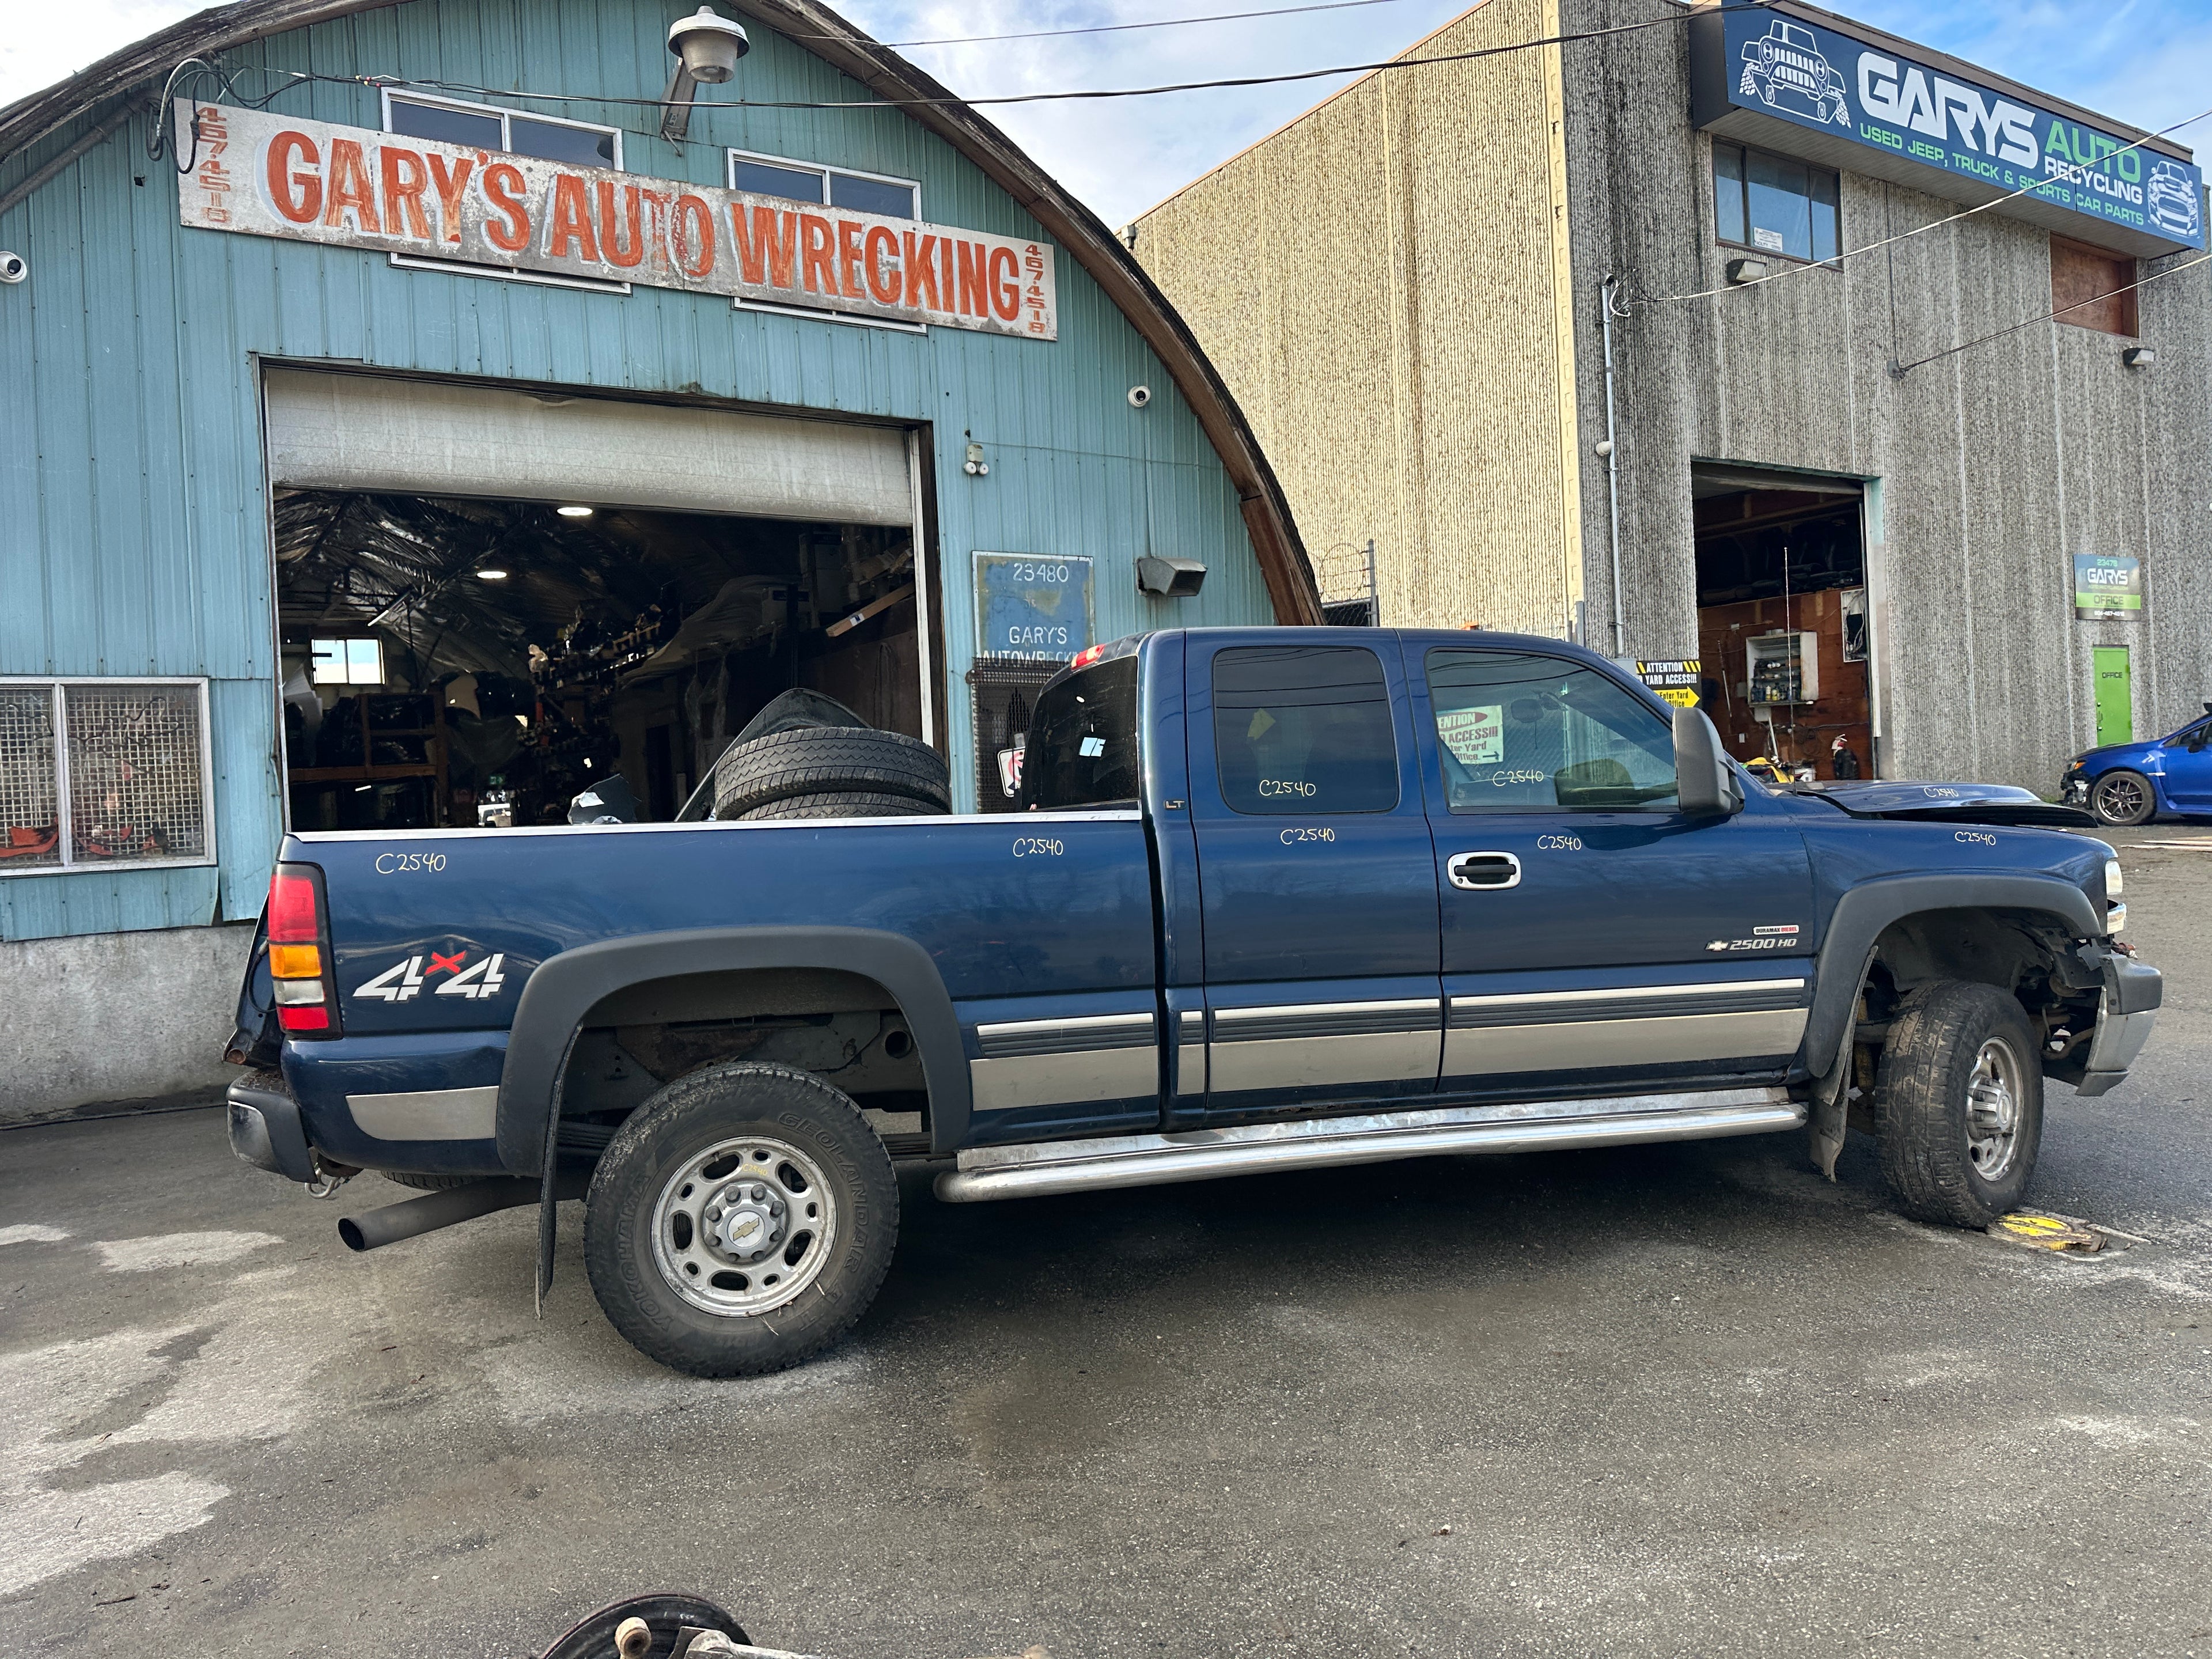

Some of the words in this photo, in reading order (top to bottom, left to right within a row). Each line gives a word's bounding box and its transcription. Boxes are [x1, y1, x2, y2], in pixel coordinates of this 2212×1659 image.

[1858, 52, 2038, 169] GARYS
[2045, 120, 2141, 183] AUTO
[1860, 123, 1903, 149] USED
[1908, 140, 1948, 167] JEEP,
[1952, 153, 1999, 180] TRUCK
[2004, 170, 2014, 184] &
[2019, 175, 2070, 202] SPORTS
[2075, 193, 2101, 212] CAR
[2105, 203, 2144, 225] PARTS
[2045, 156, 2142, 204] RECYCLING
[267, 130, 531, 251] GARY'S
[551, 175, 715, 277] AUTO
[731, 202, 1020, 321] WRECKING
[1013, 562, 1069, 583] 23480
[2087, 567, 2128, 585] GARYS
[2093, 594, 2124, 605] OFFICE
[1009, 626, 1067, 645] GARY'S
[1646, 661, 1683, 673] ATTENTION
[1645, 675, 1663, 685] YARD
[1665, 673, 1697, 684] ACCESS!!!
[1660, 692, 1674, 700] Enter
[1449, 726, 1498, 743] ACCESS!!!
[1464, 741, 1487, 752] Yard
[1492, 769, 1544, 787] C2540
[1259, 779, 1316, 797] C2540
[1923, 787, 1959, 798] C2540
[1165, 800, 1184, 809] LT
[1280, 828, 1335, 845] C2540
[1537, 835, 1582, 851] C2540
[1954, 831, 1997, 846] C2540
[1013, 838, 1063, 857] C2540
[376, 853, 446, 874] C2540
[1729, 938, 1776, 950] 2500
[1777, 938, 1797, 948] HD
[742, 1164, 768, 1176] C2540
[778, 1112, 868, 1273] GEOLANDAR
[618, 1174, 671, 1331] YOKOHAMA
